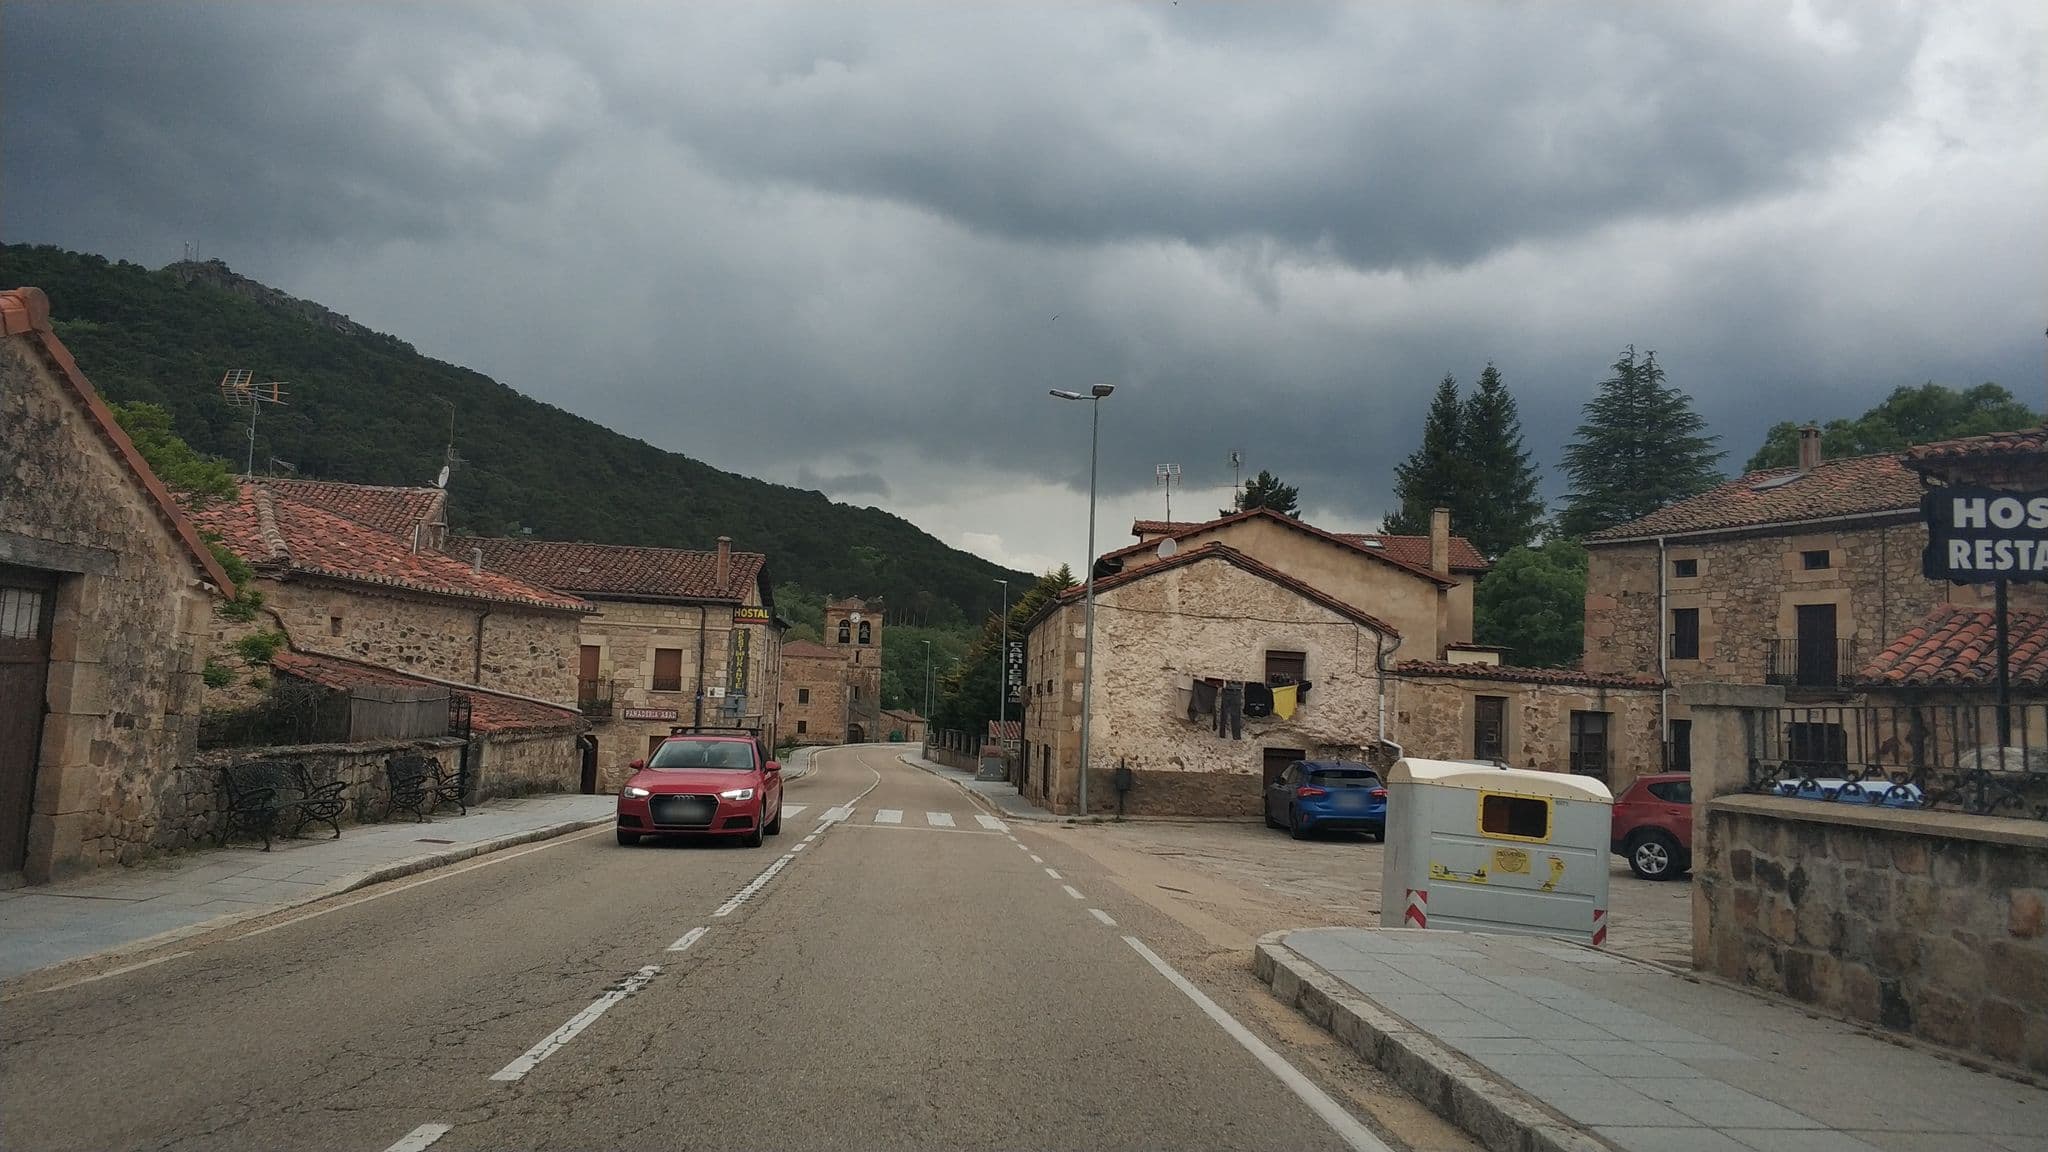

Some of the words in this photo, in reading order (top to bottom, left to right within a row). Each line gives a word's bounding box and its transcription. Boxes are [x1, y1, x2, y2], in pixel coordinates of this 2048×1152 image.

[1953, 497, 2048, 529] HOS
[734, 608, 769, 618] HOSTAL
[1009, 641, 1023, 696] CARNICERIA
